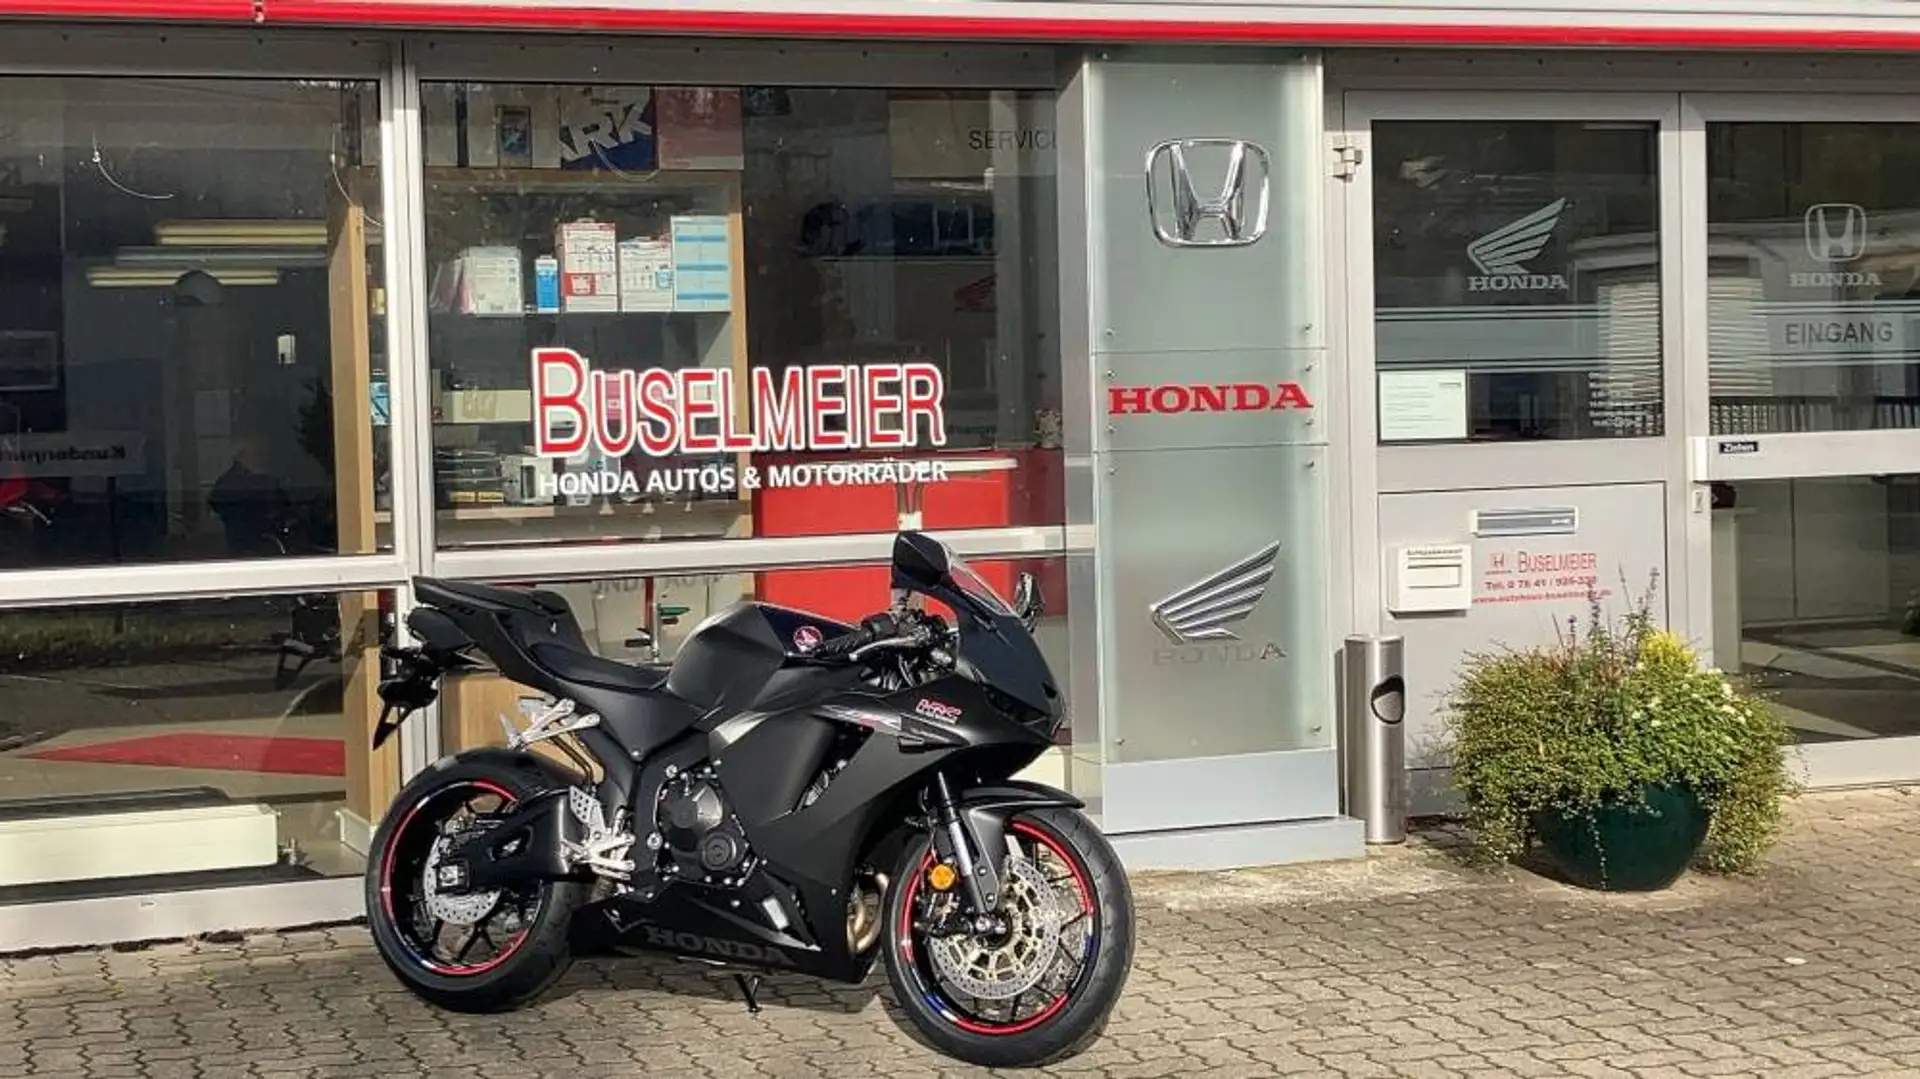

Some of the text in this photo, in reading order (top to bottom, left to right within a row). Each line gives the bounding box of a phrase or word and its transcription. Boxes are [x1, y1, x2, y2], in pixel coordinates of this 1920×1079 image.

[1467, 274, 1569, 291] HONDA
[1789, 272, 1882, 287] HONDA
[1784, 321, 1893, 345] EINGANG
[531, 347, 947, 458] BUSELMEIER
[1107, 383, 1314, 415] HONDA
[540, 458, 949, 496] HONDA AUTOS & MOTORRÄDER
[646, 925, 797, 966] HONDA
